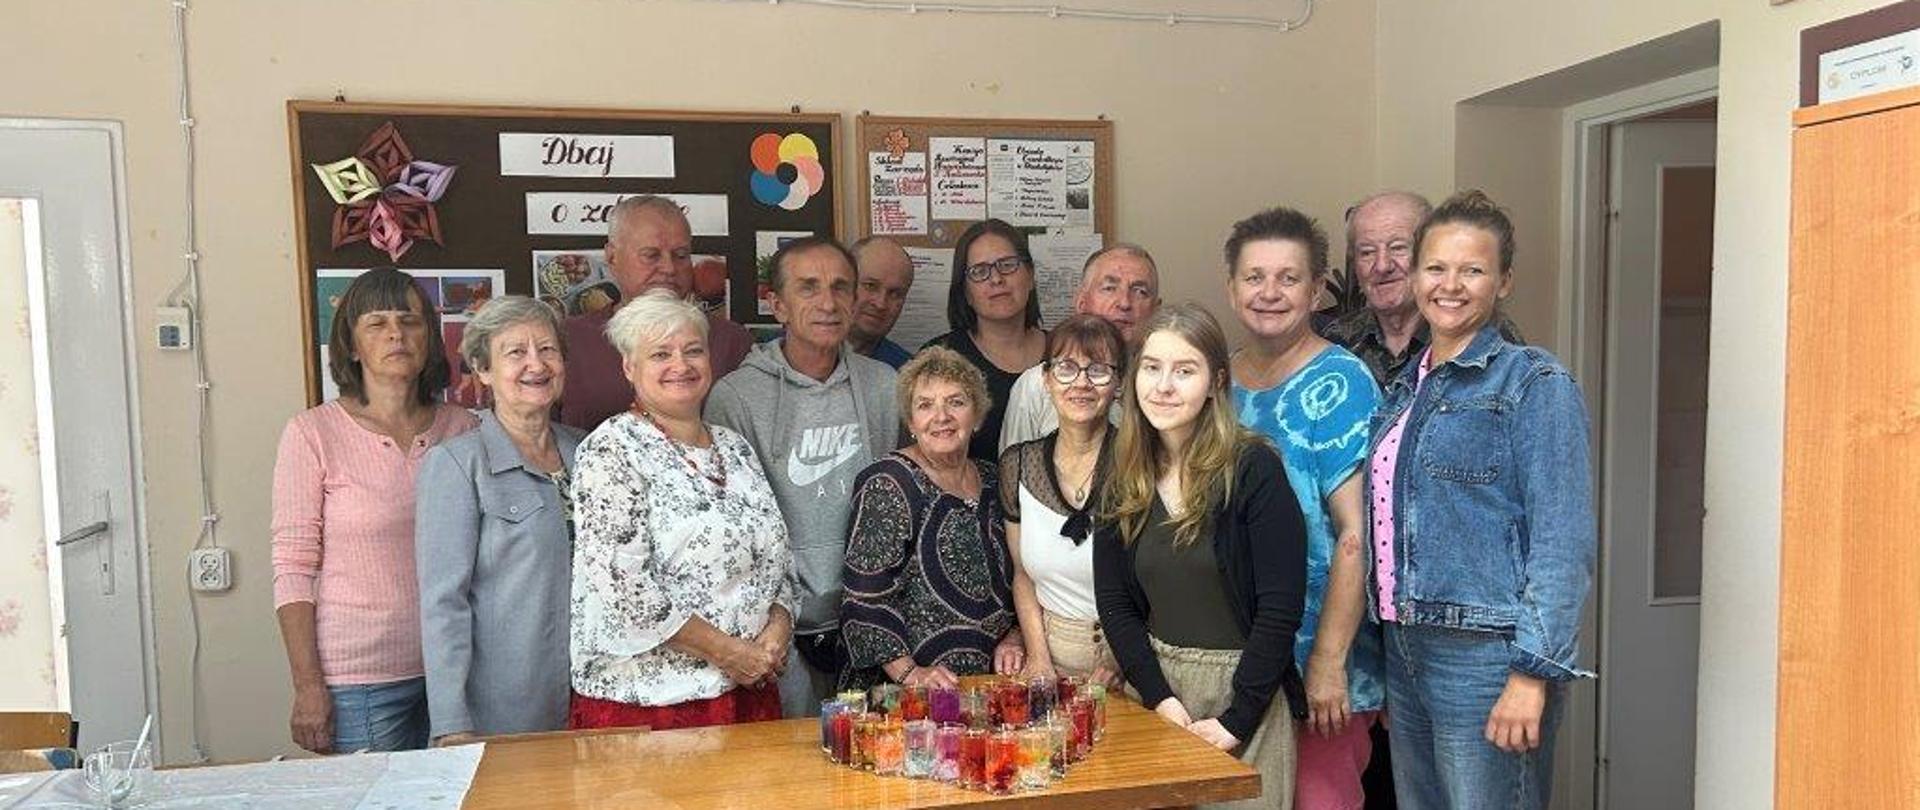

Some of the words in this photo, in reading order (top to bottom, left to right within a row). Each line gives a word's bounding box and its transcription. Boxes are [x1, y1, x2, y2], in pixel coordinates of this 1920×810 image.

[542, 136, 614, 175] Dbaj
[551, 204, 568, 223] o
[799, 423, 860, 459] NIKE
